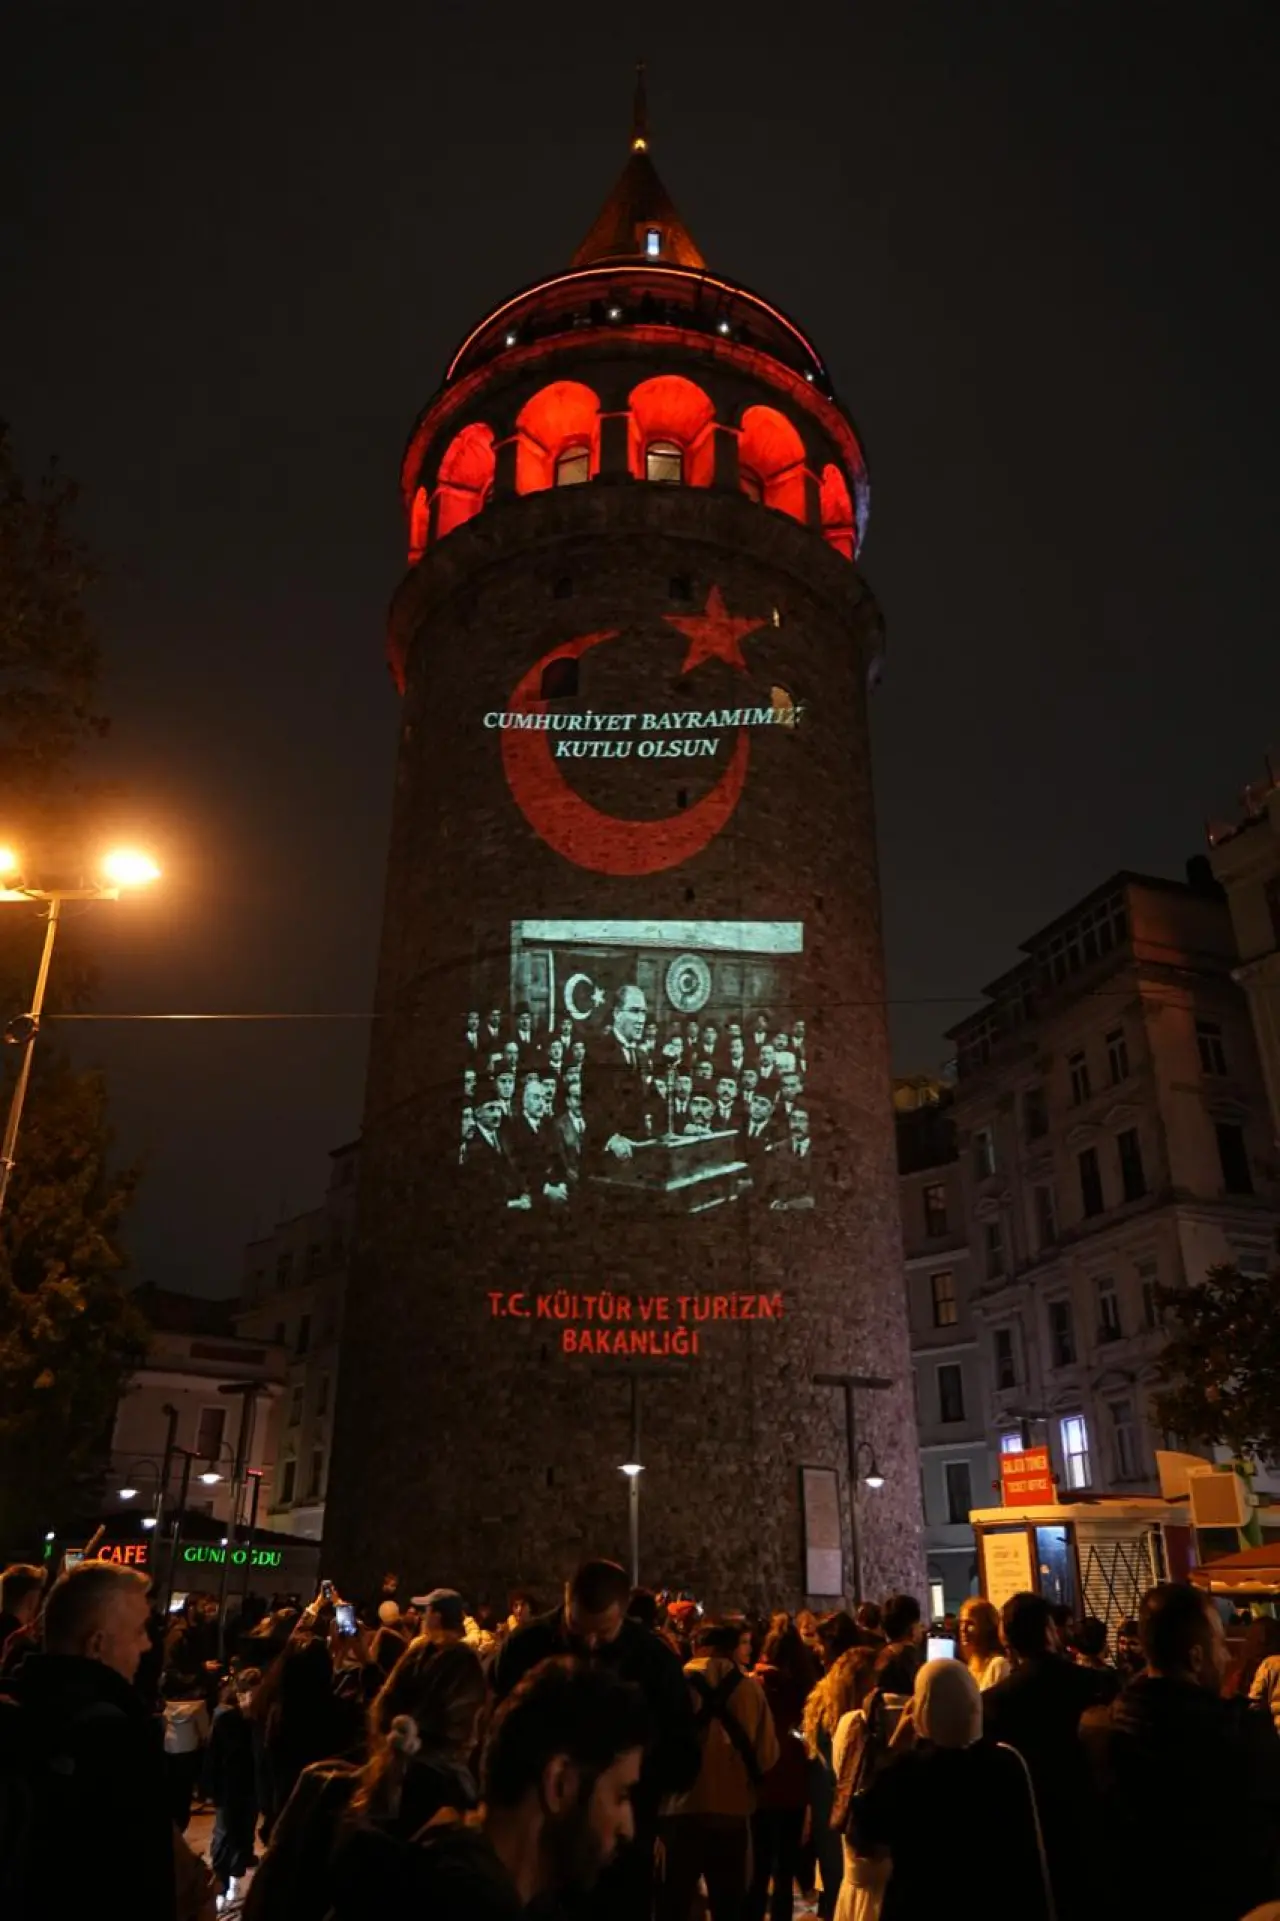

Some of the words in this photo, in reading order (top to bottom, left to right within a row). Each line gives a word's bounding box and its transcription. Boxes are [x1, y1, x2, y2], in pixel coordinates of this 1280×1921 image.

[483, 709, 636, 731] CUMHURİYET
[555, 740, 631, 758] KUTLU
[638, 739, 719, 758] OLSUN
[488, 1292, 531, 1317] T.C.
[537, 1290, 631, 1321] KÜLTÜR
[638, 1296, 670, 1321] VE
[678, 1290, 784, 1321] TURİZM
[563, 1328, 699, 1355] BAKANLIĞI
[97, 1543, 148, 1564] CAFE
